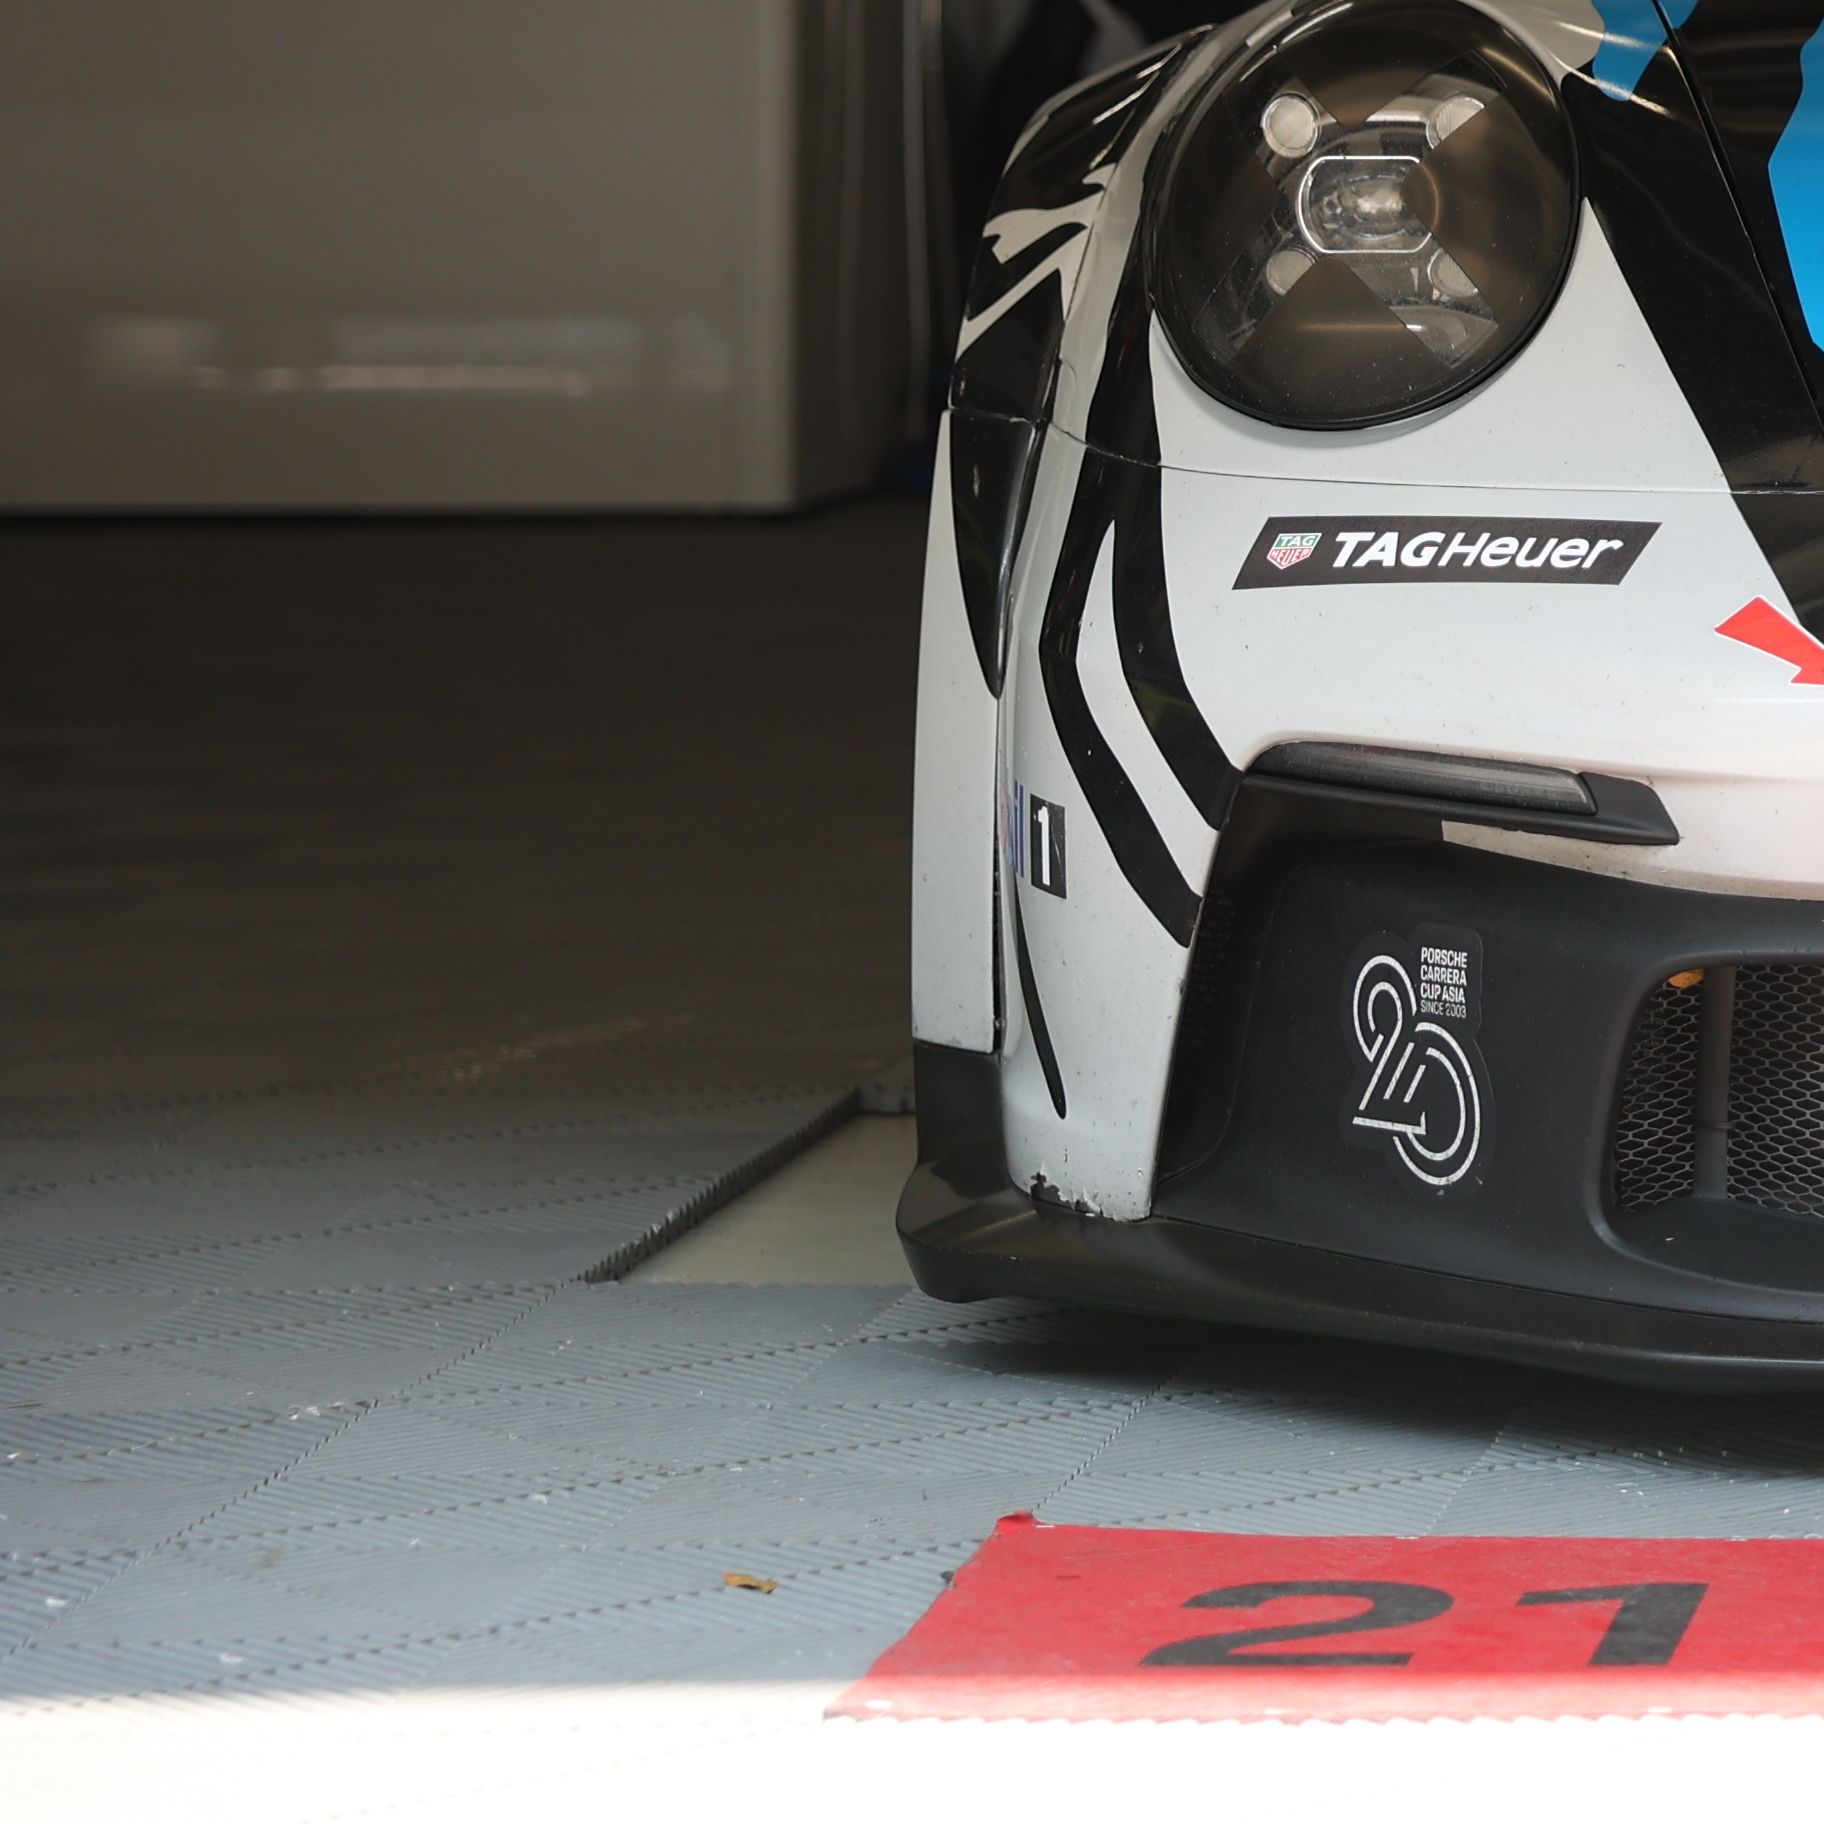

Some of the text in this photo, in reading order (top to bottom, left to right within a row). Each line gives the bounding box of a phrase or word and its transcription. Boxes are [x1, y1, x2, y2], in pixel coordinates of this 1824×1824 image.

[1280, 535, 1316, 547] TAG
[1421, 947, 1468, 968] PORSCHE
[1420, 964, 1467, 987] CARRERA
[1420, 983, 1466, 1004] CUP ASIA
[1420, 1000, 1466, 1018] SINCE 2003
[1136, 1579, 1709, 1668] 21
